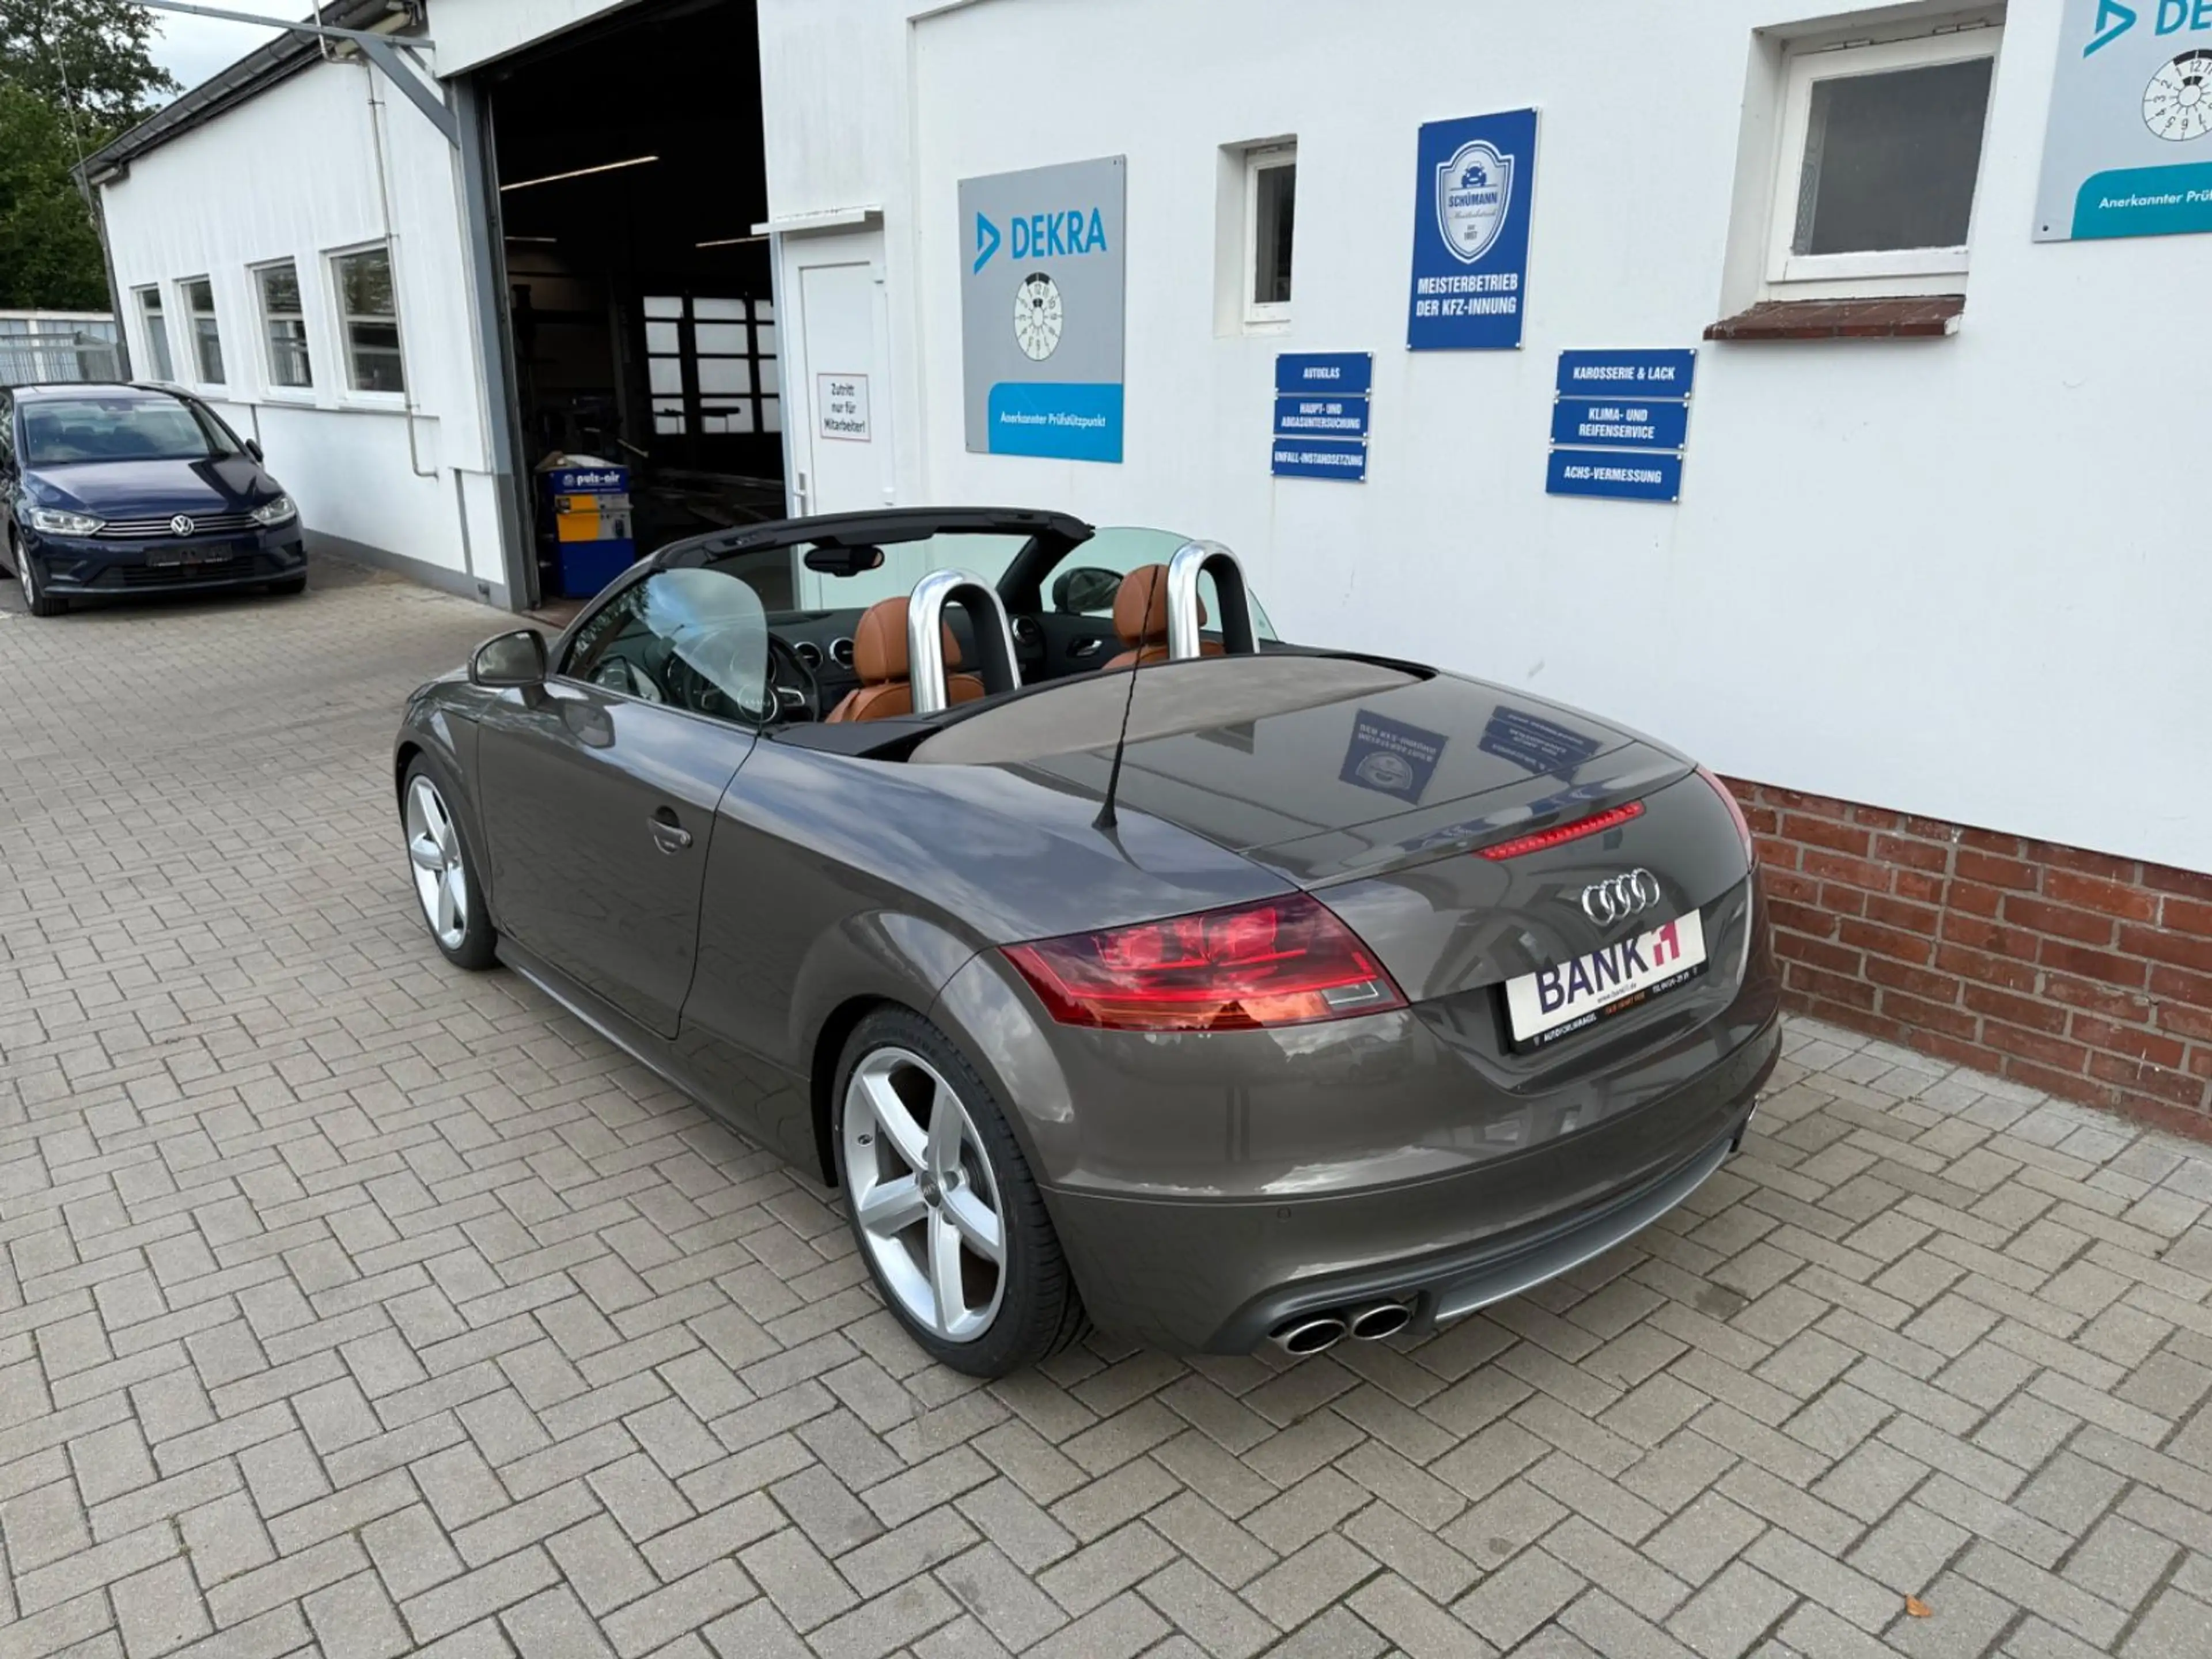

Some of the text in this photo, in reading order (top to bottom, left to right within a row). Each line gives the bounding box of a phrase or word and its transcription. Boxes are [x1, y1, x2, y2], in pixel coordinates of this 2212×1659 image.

[1448, 191, 1498, 207] SCHÜMANN
[2099, 194, 2184, 209] Anerkannter
[1012, 207, 1107, 259] DEKRA
[1417, 273, 1518, 294] MEISTERBETRIEB
[1416, 297, 1517, 316] DER KFZ-INNUNG
[1302, 367, 1340, 379] AUTOGLAS
[1573, 366, 1675, 380] KAROSSERIE & LACK
[1299, 403, 1342, 415] HAUPT- UND
[1589, 408, 1649, 422] KLIMA- UND
[1000, 410, 1106, 429] Anerkannter Prüfstützpunkt
[1281, 416, 1361, 429] ABGASUNTERSUCHUNG
[1578, 424, 1655, 439] REIFENSERVICE
[1563, 465, 1662, 484] ACHS-VERMESSUNG
